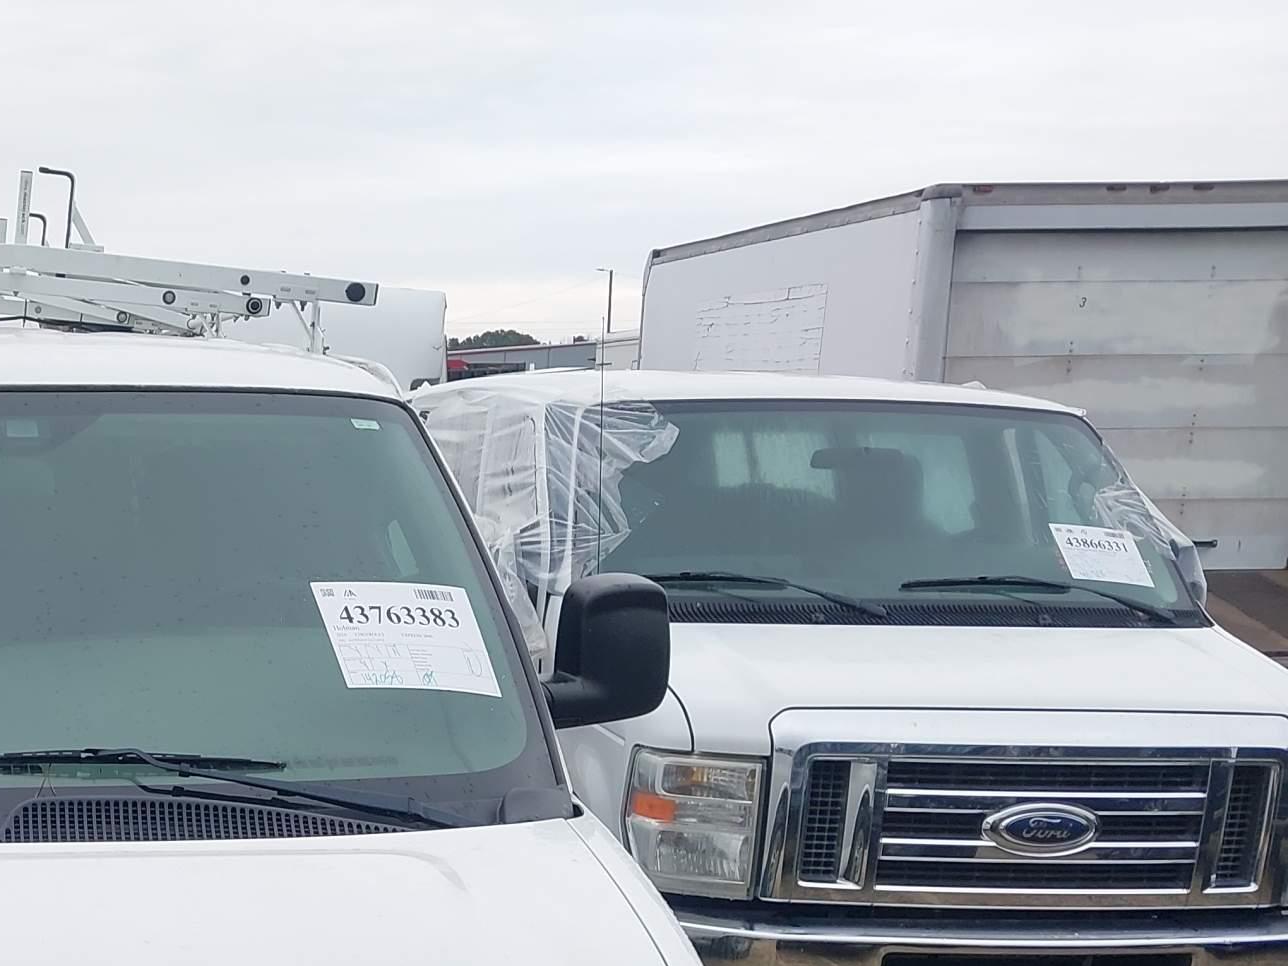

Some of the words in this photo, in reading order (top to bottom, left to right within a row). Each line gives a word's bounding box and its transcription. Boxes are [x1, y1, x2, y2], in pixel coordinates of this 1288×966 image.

[1078, 296, 1088, 309] 3
[1065, 536, 1129, 553] 43866331
[339, 604, 460, 628] 43763383
[1021, 816, 1072, 839] Ford
